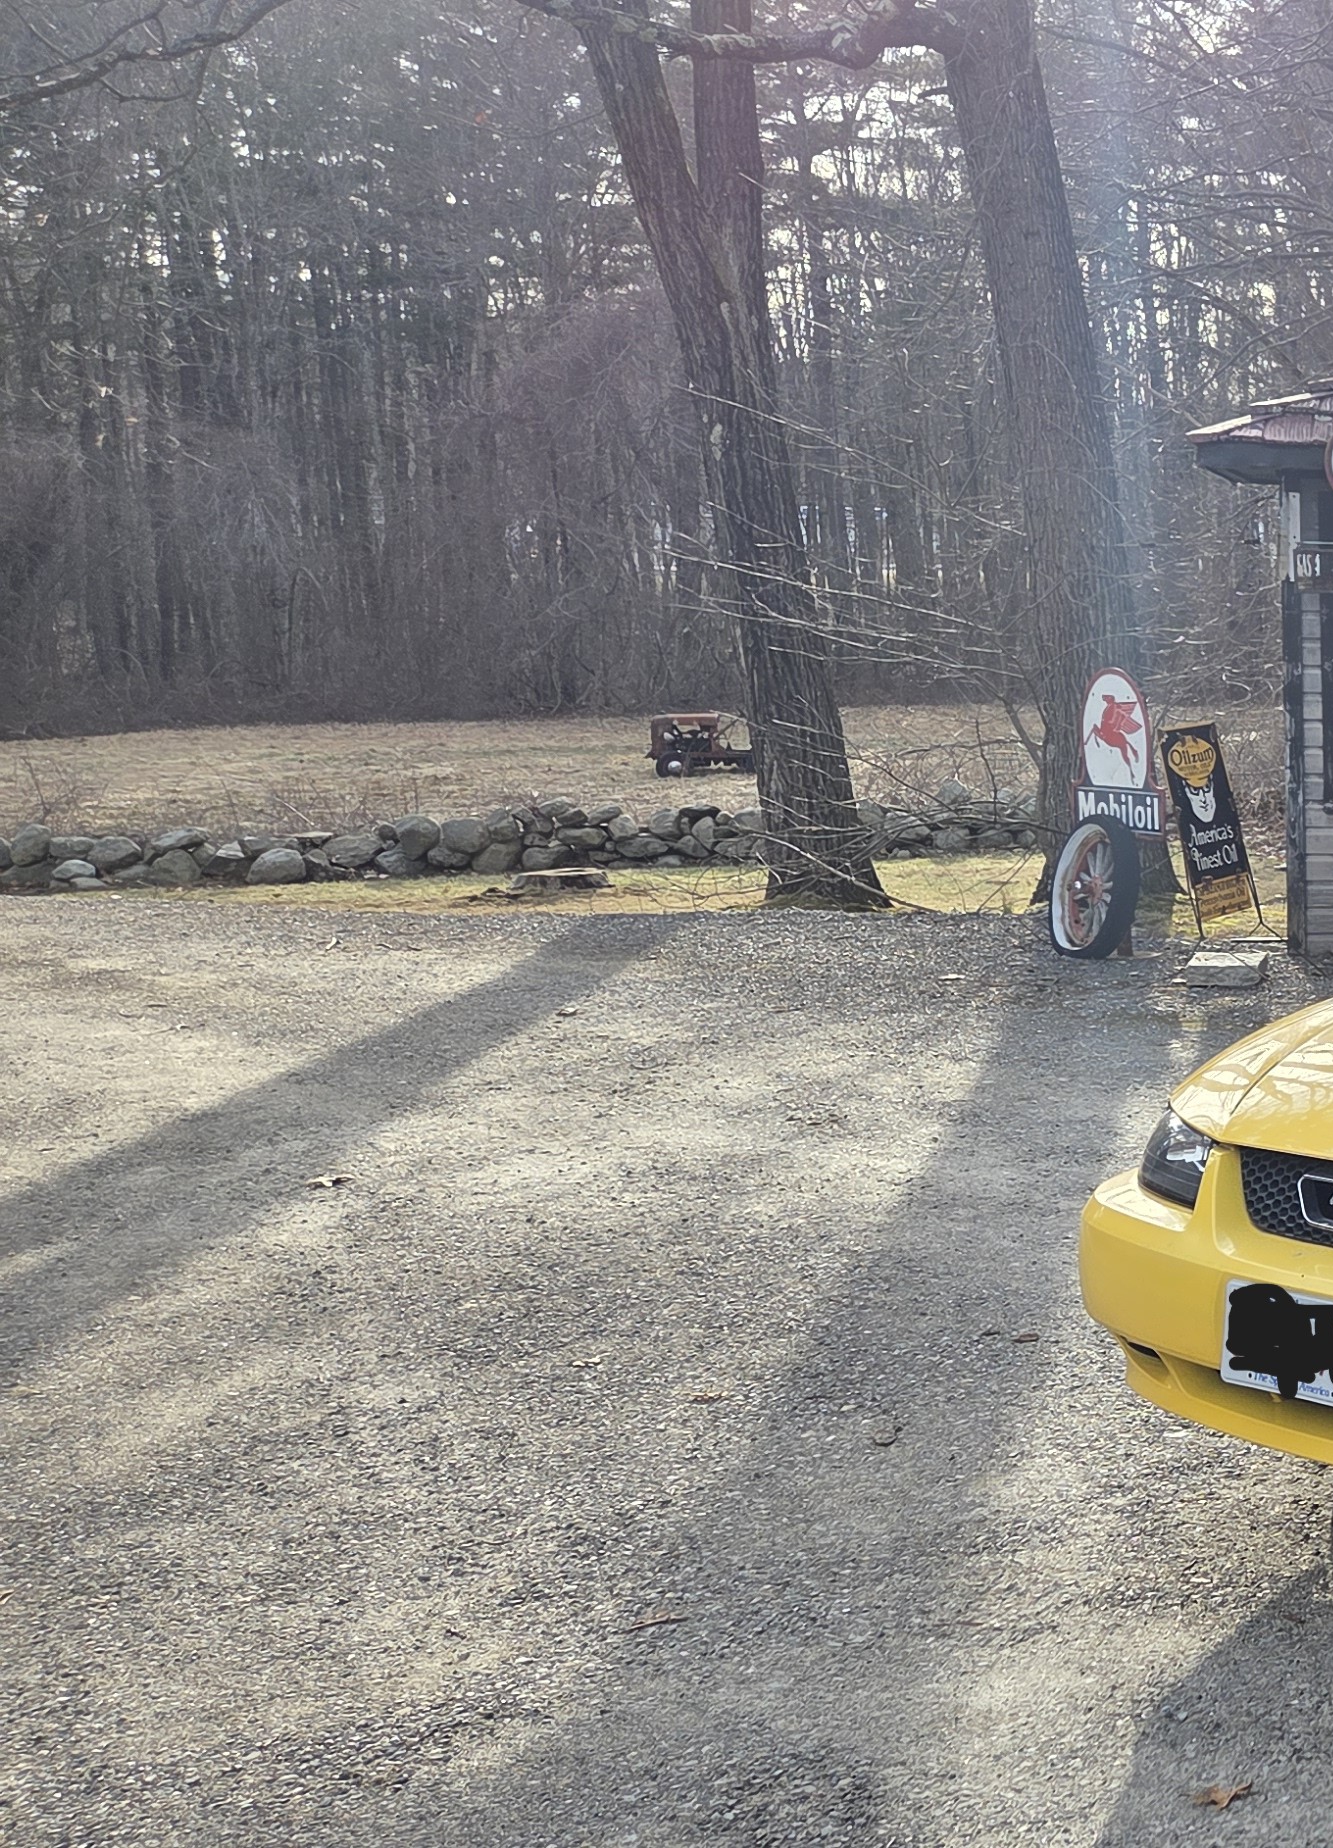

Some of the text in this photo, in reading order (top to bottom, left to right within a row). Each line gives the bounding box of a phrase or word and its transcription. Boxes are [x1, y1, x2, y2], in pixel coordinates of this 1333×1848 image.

[1170, 747, 1214, 767] Oilzum
[1078, 791, 1160, 830] Mobiloil
[1188, 823, 1235, 848] America's
[1190, 843, 1238, 871] Finest Oil
[1299, 1383, 1330, 1397] America
